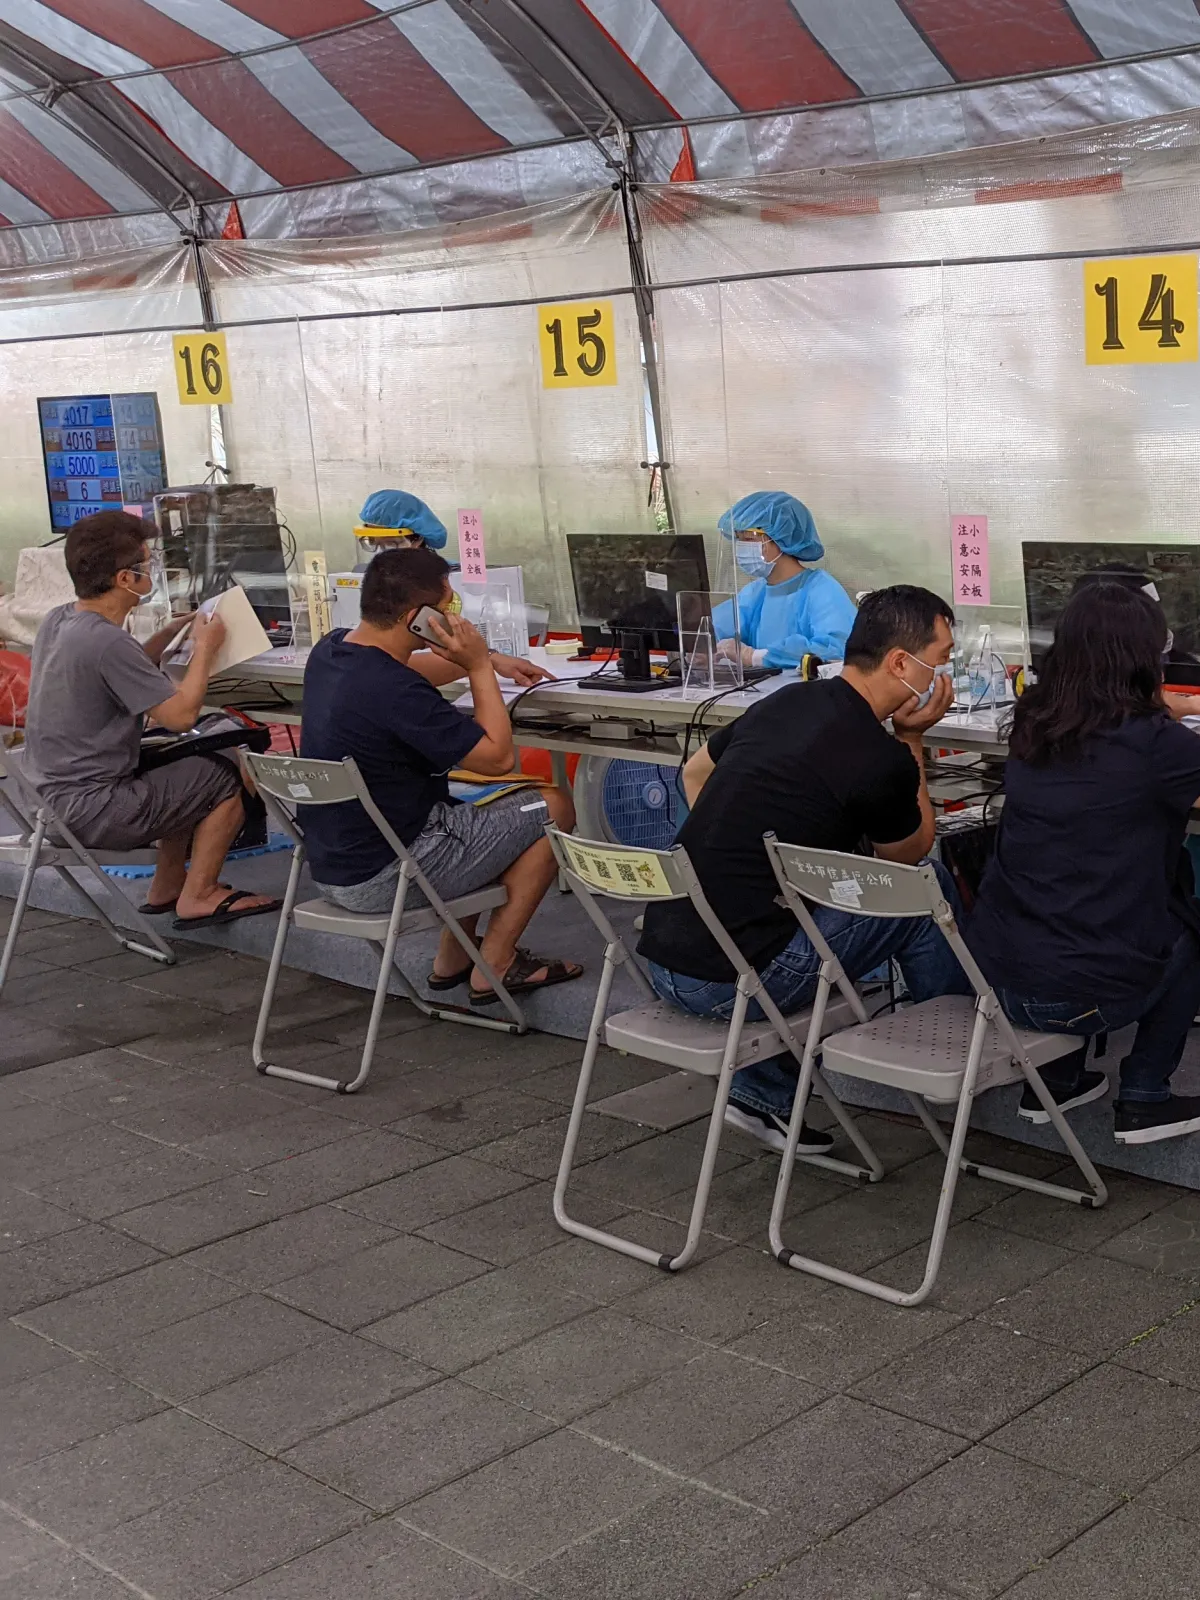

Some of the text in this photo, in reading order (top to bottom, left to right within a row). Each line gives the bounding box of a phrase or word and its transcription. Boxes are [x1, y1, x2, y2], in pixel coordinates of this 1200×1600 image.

[1094, 273, 1185, 350] 14
[179, 342, 223, 396] 16
[545, 308, 607, 377] 15
[64, 405, 89, 425] 4017
[66, 431, 93, 450] 4016
[68, 456, 95, 475] 5000
[80, 481, 89, 501] 6
[957, 524, 971, 596] 注意安全
[969, 524, 983, 598] 小心隔板
